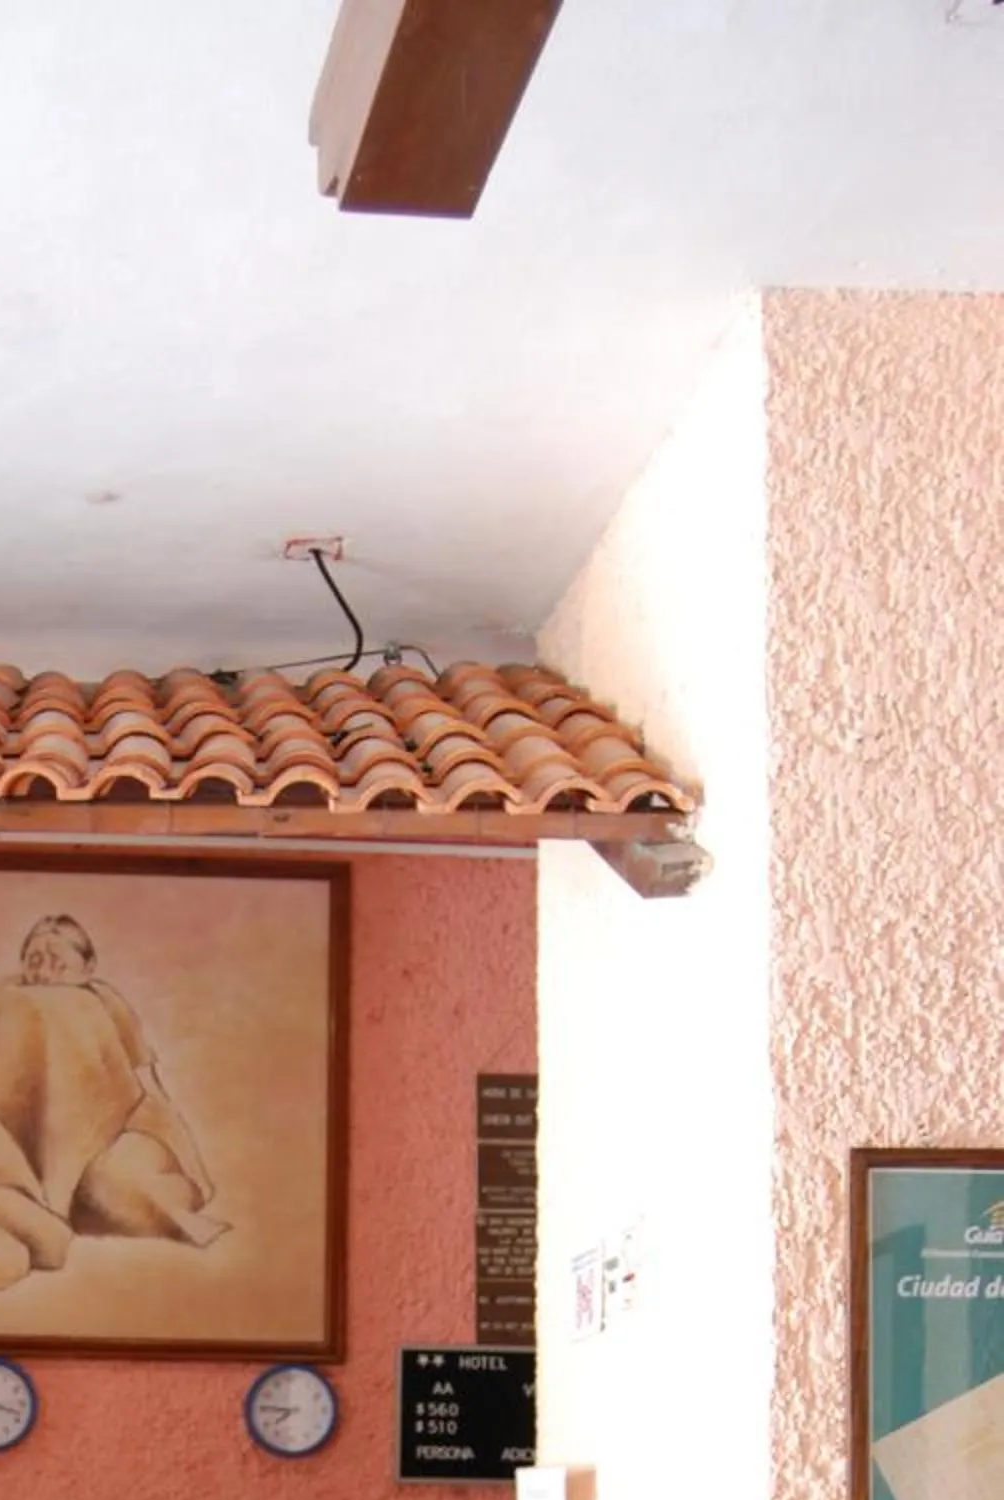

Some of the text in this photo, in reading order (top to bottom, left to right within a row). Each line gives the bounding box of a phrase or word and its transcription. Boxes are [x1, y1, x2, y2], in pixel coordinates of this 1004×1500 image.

[897, 1274, 981, 1298] Ciudad
[458, 1354, 509, 1371] HOTEL
[432, 1380, 455, 1396] AA
[416, 1445, 476, 1461] PERSONA
